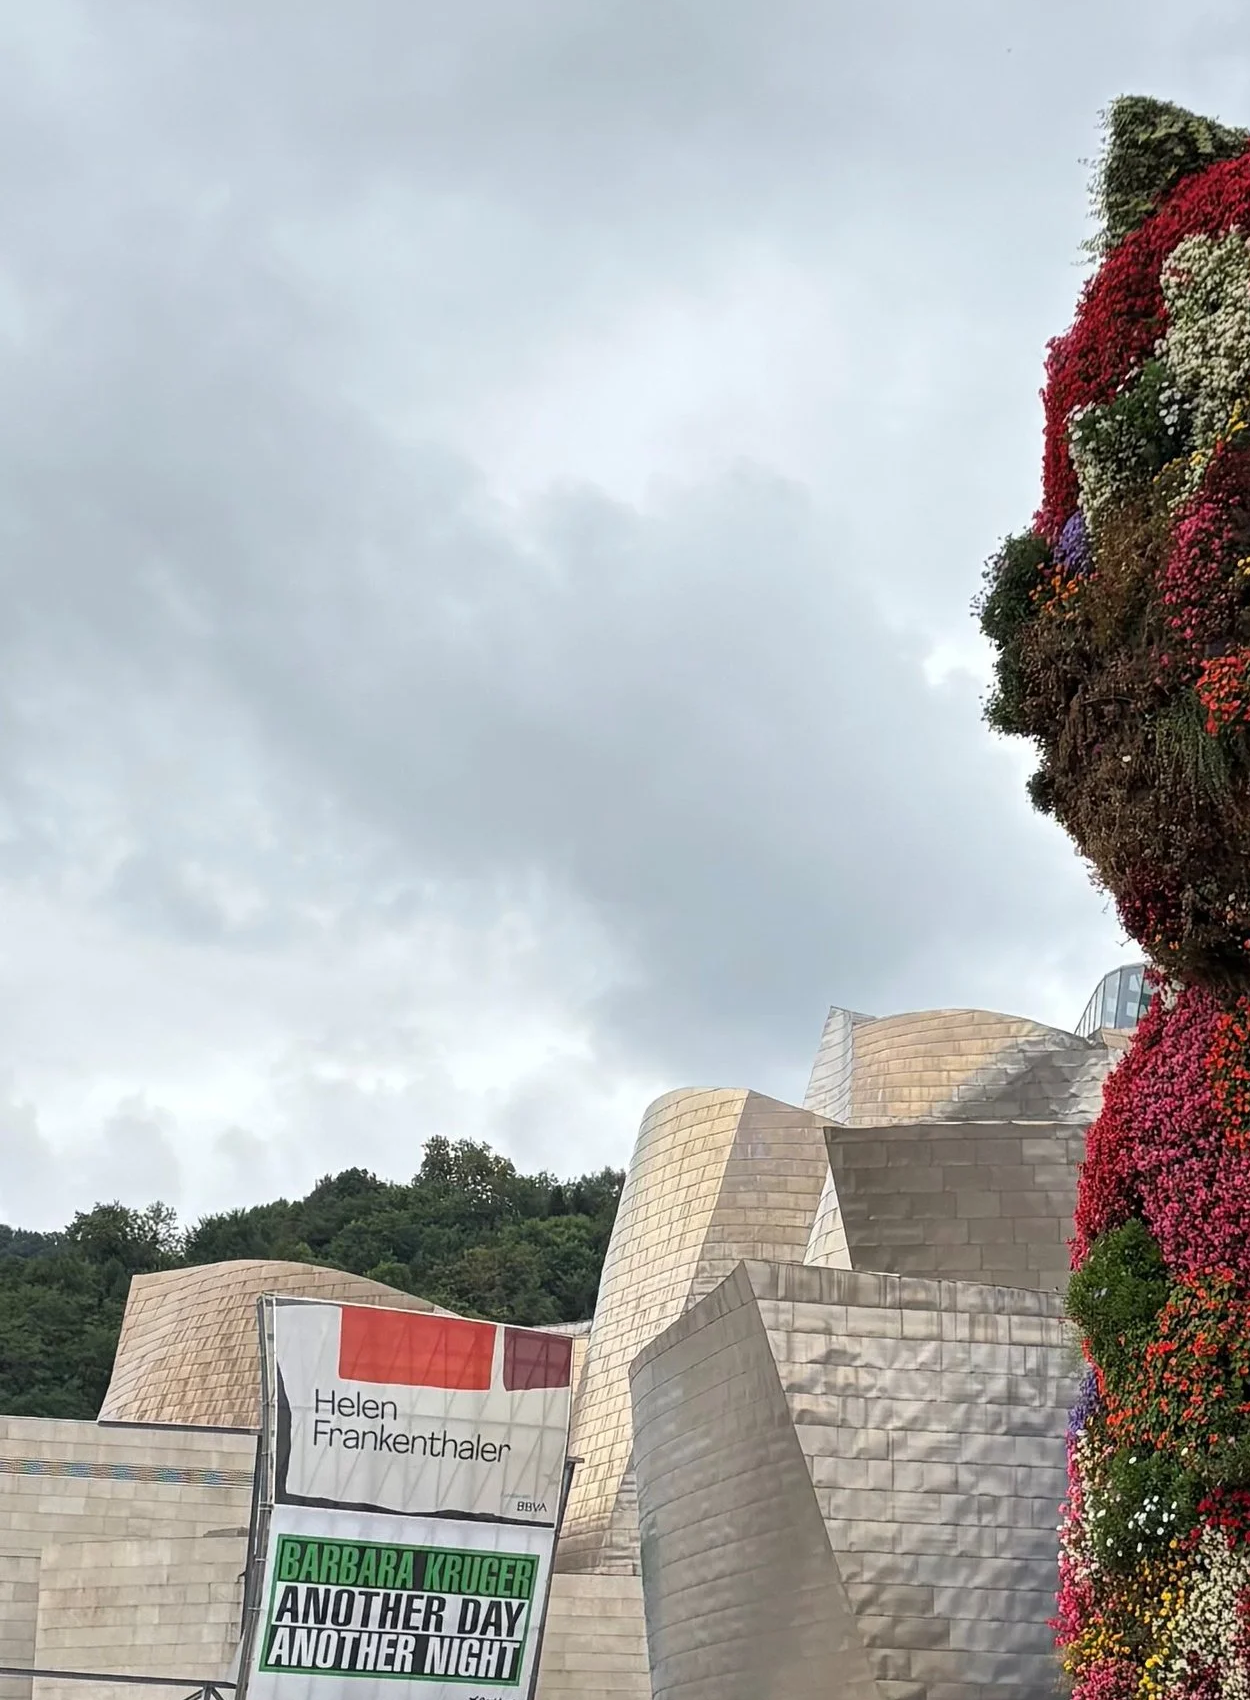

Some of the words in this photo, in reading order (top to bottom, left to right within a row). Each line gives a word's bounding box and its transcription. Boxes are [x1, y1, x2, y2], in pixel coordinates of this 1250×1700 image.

[315, 1388, 397, 1421] Helen
[313, 1419, 511, 1463] Frankenthaler
[516, 1500, 547, 1513] BBVA
[279, 1541, 414, 1590] BARBARA
[423, 1551, 533, 1598] KRUGER
[275, 1585, 447, 1633] ANOTHER
[457, 1598, 526, 1638] DAY
[267, 1626, 417, 1673] ANOTHER
[424, 1636, 520, 1679] NIGHT
